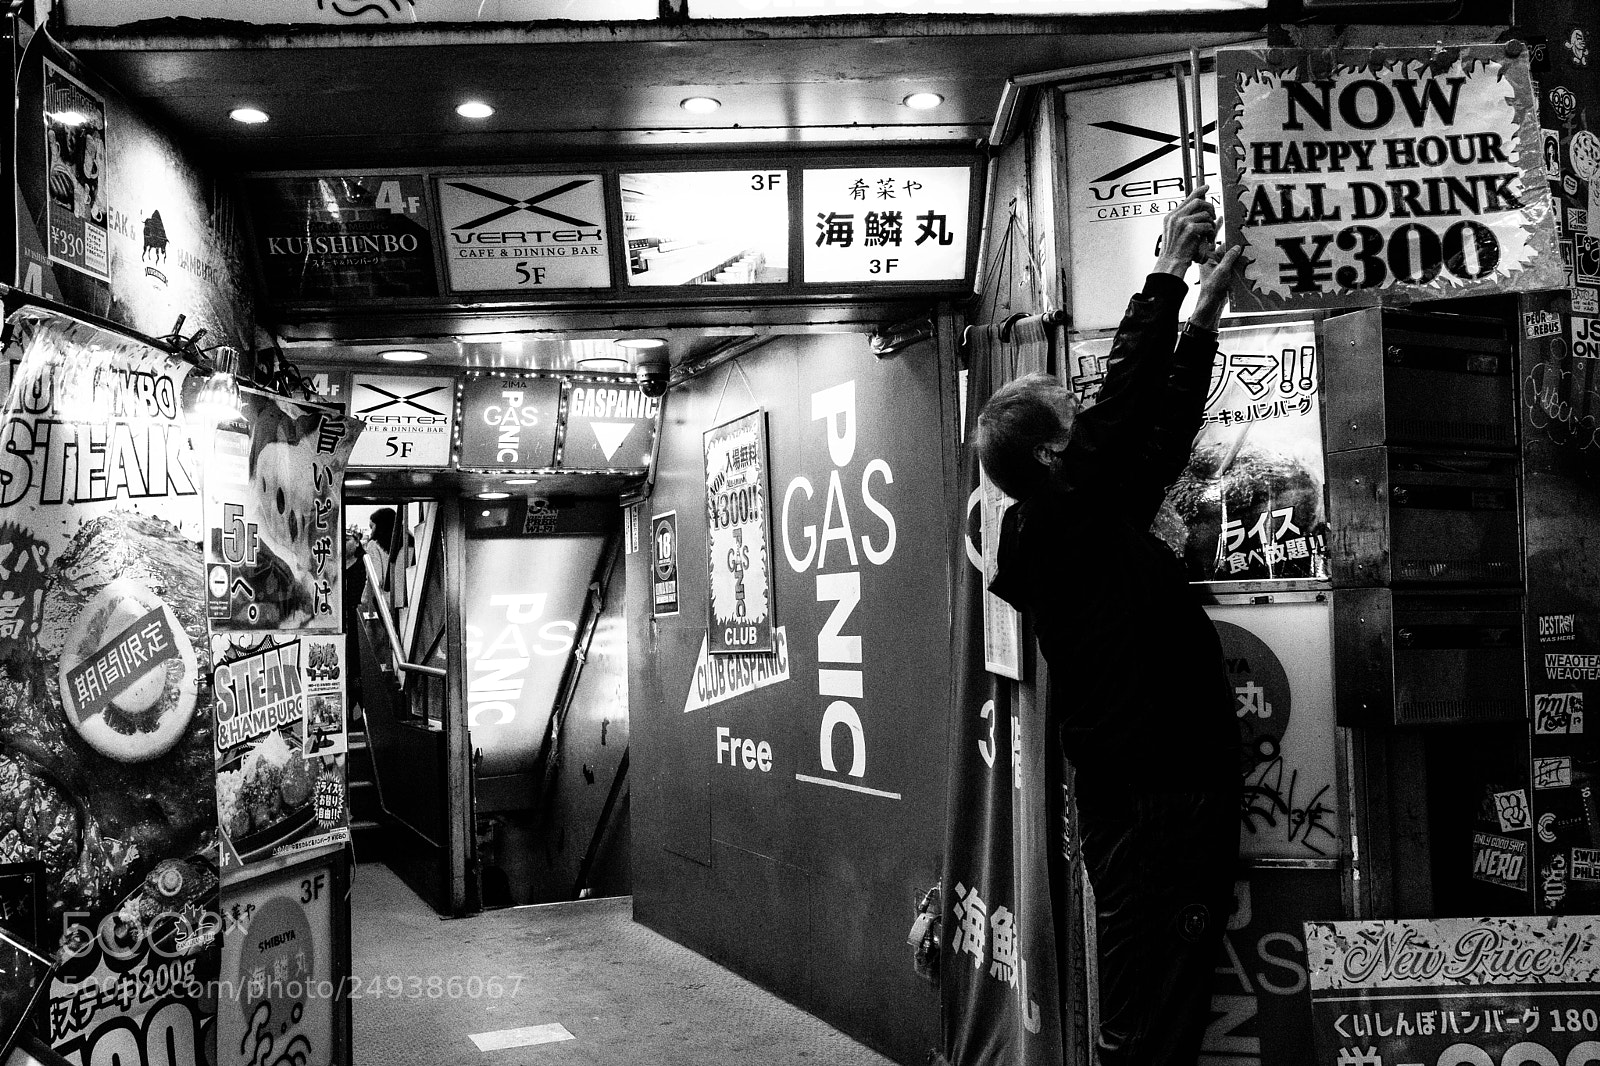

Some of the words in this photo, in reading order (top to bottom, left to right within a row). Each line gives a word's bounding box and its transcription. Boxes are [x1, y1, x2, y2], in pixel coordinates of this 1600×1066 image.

[1282, 76, 1467, 132] NOW
[1251, 140, 1375, 175] HAPPY
[1383, 132, 1509, 167] HOUR
[375, 180, 420, 214] 4F
[751, 174, 782, 191] 3F
[848, 178, 923, 200] 肴菜や
[1098, 204, 1142, 219] CAFE
[1149, 202, 1160, 214] &
[1246, 181, 1342, 228] ALL
[1351, 172, 1526, 221] DRINK
[51, 225, 84, 258] ¥330
[267, 233, 418, 255] KUISHINBO
[451, 229, 603, 245] VERTEX
[815, 210, 954, 248] 海鱗丸
[459, 247, 496, 258] CAFE
[500, 247, 509, 257] &
[514, 246, 567, 257] DINING
[572, 246, 599, 255] BAR
[869, 259, 899, 274] 3F
[1276, 220, 1501, 294] ¥300
[516, 262, 546, 285] 5F
[502, 380, 527, 388] ZIMA
[483, 406, 539, 427] GAS
[571, 388, 658, 419] GASPANIC
[0, 418, 198, 508] STEAK
[385, 436, 414, 458] 5F
[312, 417, 346, 616] 旨いピザは
[782, 458, 897, 573] GAS
[1221, 506, 1300, 551] ライス
[223, 503, 258, 564] 5F
[657, 532, 671, 559] 18
[1227, 535, 1326, 574] 食べ放題!!
[811, 380, 866, 778] PANIC
[724, 627, 757, 646] CLUB
[74, 620, 169, 710] 期間限定
[697, 657, 726, 702] CLUB
[716, 726, 773, 772] Free
[1473, 849, 1524, 882] NERO
[301, 875, 324, 904] 3F
[258, 928, 296, 953] SHIBUYA
[1343, 930, 1446, 982] New
[1445, 926, 1581, 980] Price!
[141, 958, 197, 998] 200g
[1333, 1007, 1541, 1040] くいしんぼハンバーグ
